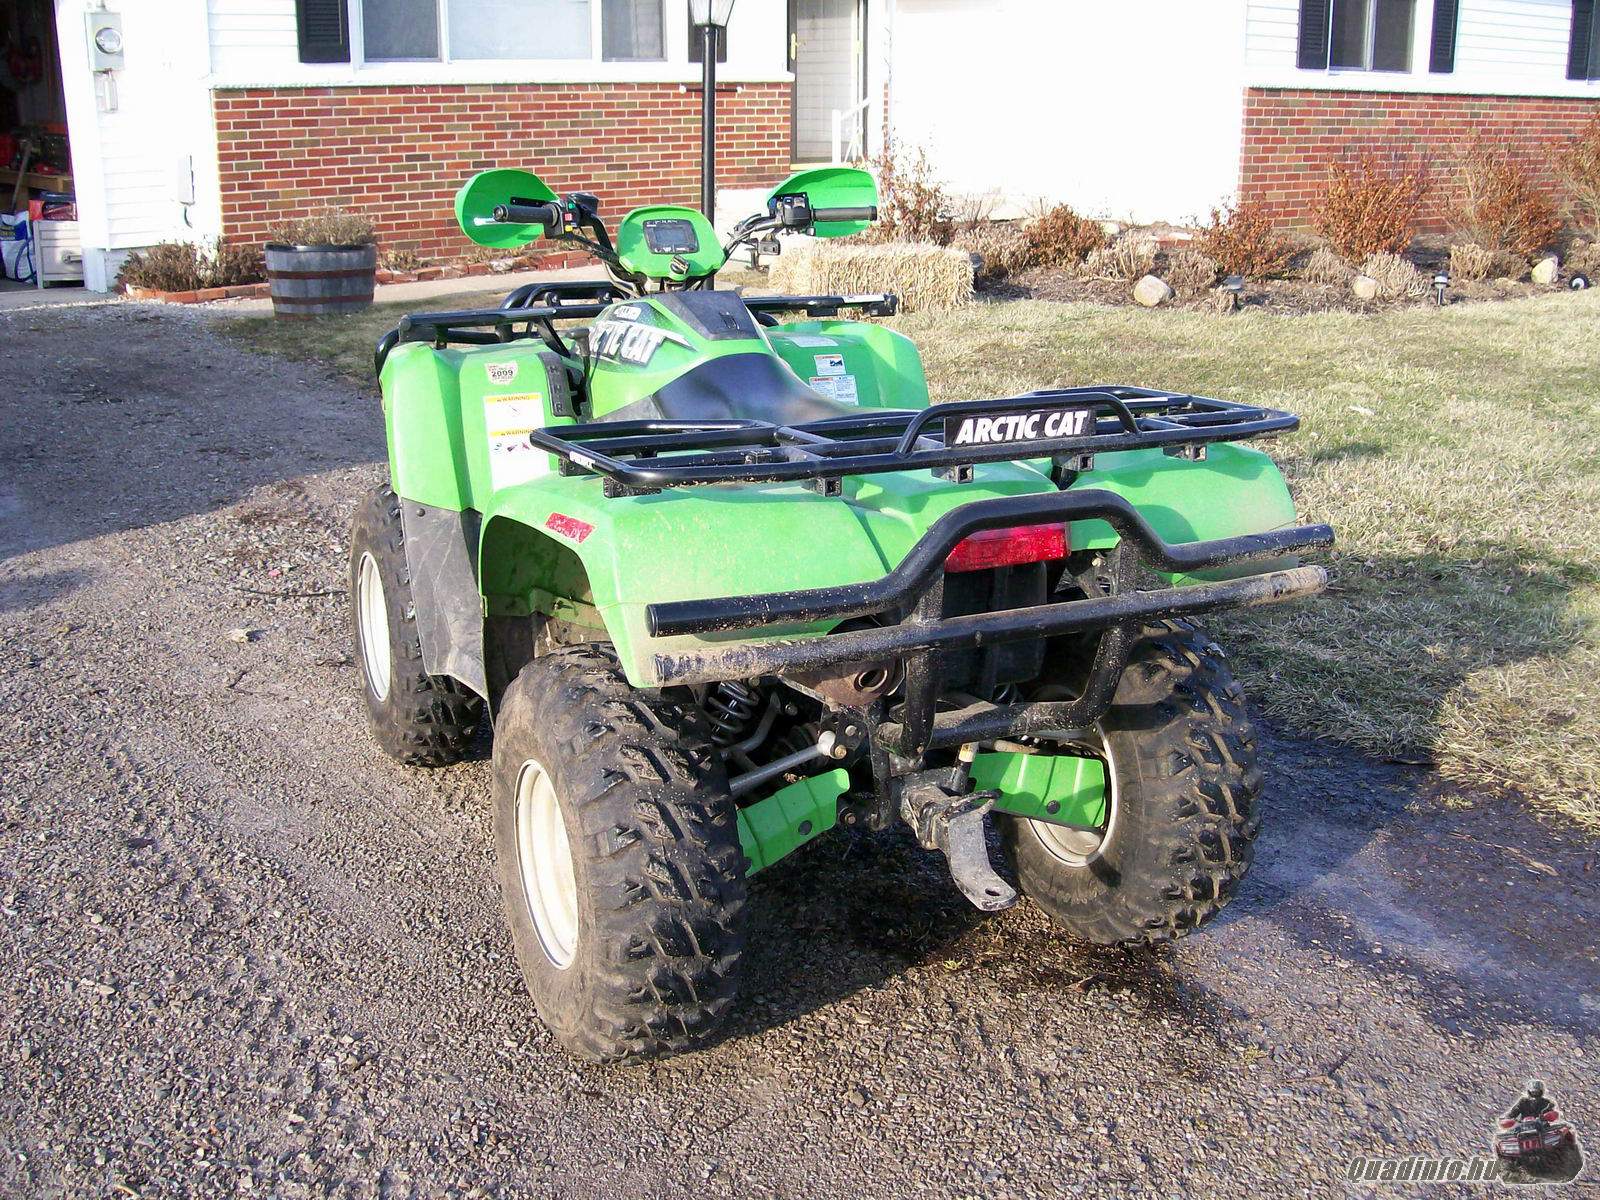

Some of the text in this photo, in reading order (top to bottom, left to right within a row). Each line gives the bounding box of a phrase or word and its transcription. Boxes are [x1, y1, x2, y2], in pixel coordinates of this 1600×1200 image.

[620, 325, 664, 364] CAT
[491, 369, 514, 378] 2009
[955, 410, 1089, 445] ARCTIC CAT
